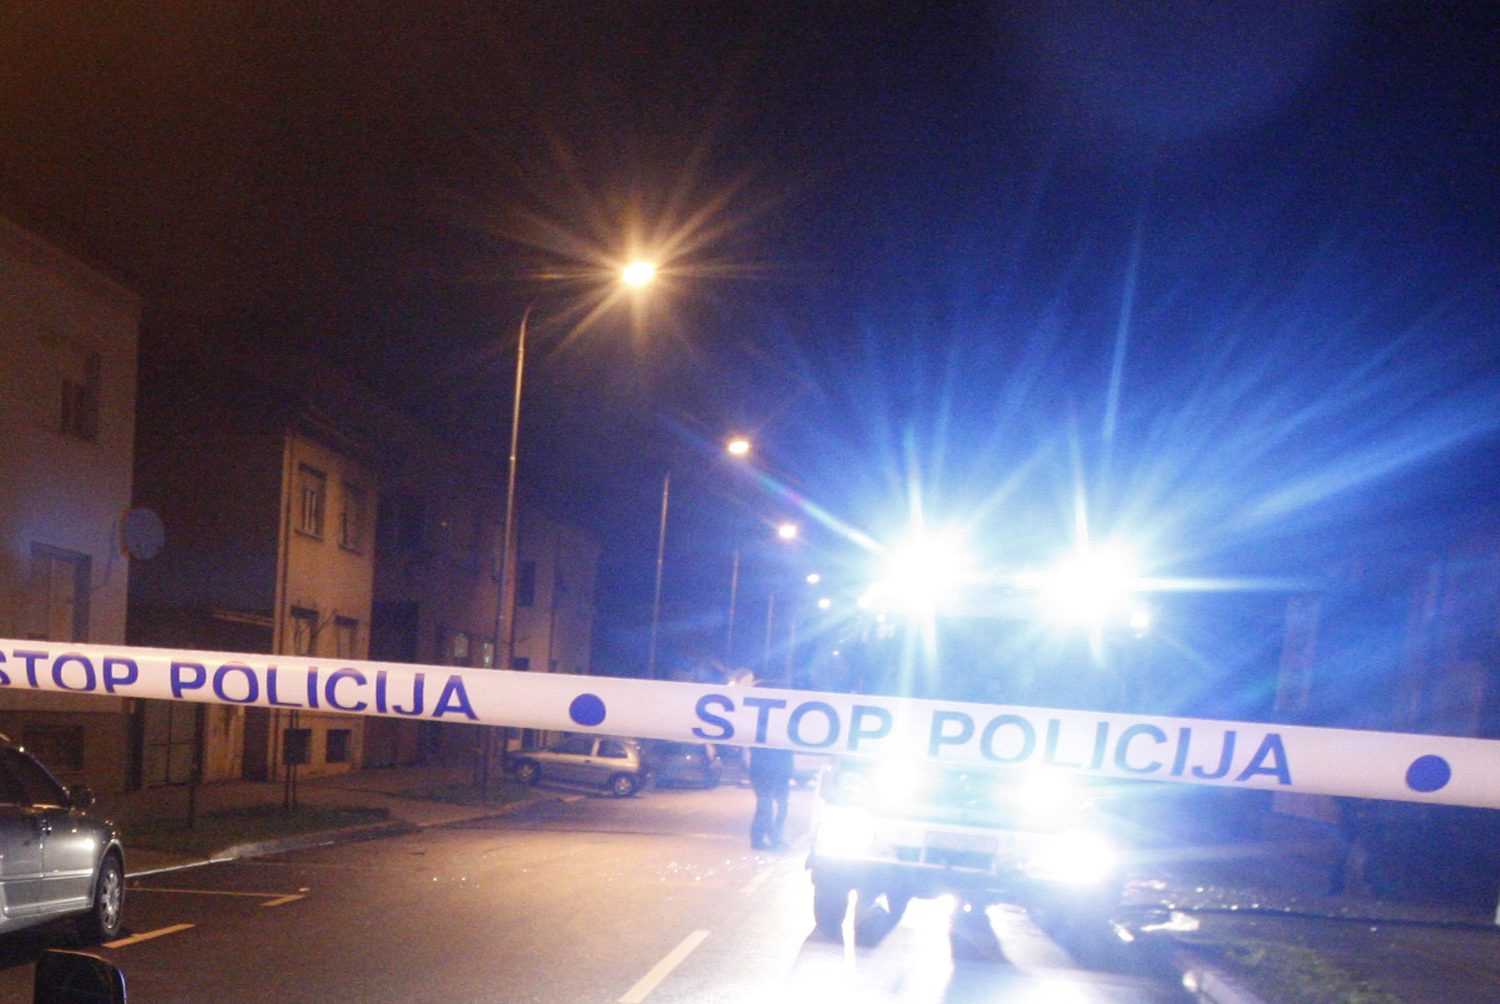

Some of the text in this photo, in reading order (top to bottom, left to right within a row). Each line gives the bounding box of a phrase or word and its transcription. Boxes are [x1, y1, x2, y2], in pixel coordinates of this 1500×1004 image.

[170, 660, 478, 720] POLICIJA
[692, 694, 1293, 786] STOP POLICIJA
